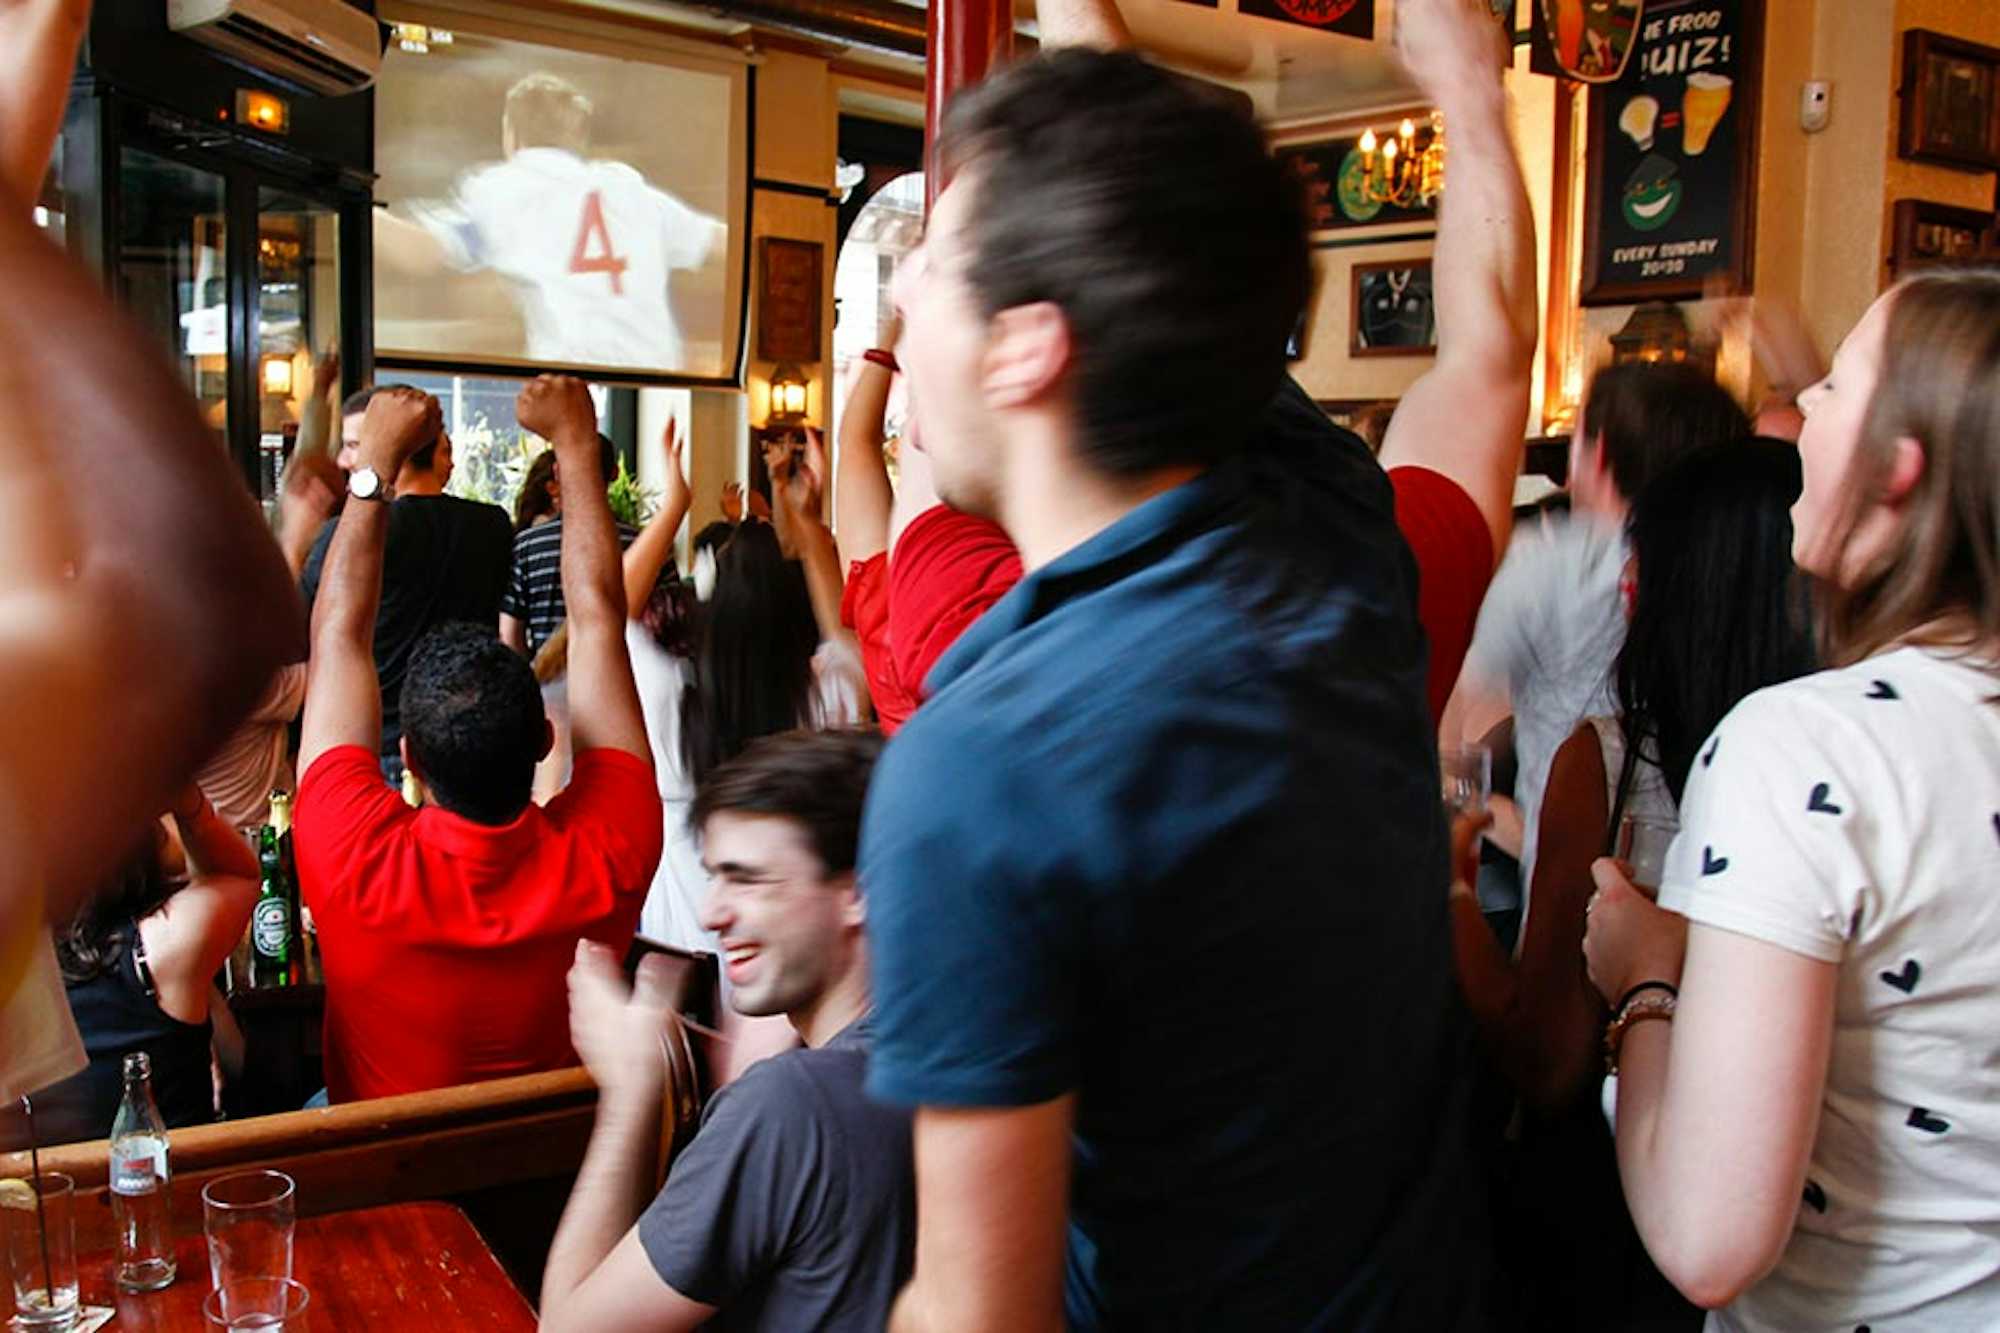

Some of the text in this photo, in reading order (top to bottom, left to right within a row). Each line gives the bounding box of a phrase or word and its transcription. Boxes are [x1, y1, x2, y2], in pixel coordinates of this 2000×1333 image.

[1640, 34, 1731, 80] UIZ!
[568, 188, 629, 297] 4
[1613, 238, 1719, 263] EVERY SUNDAY
